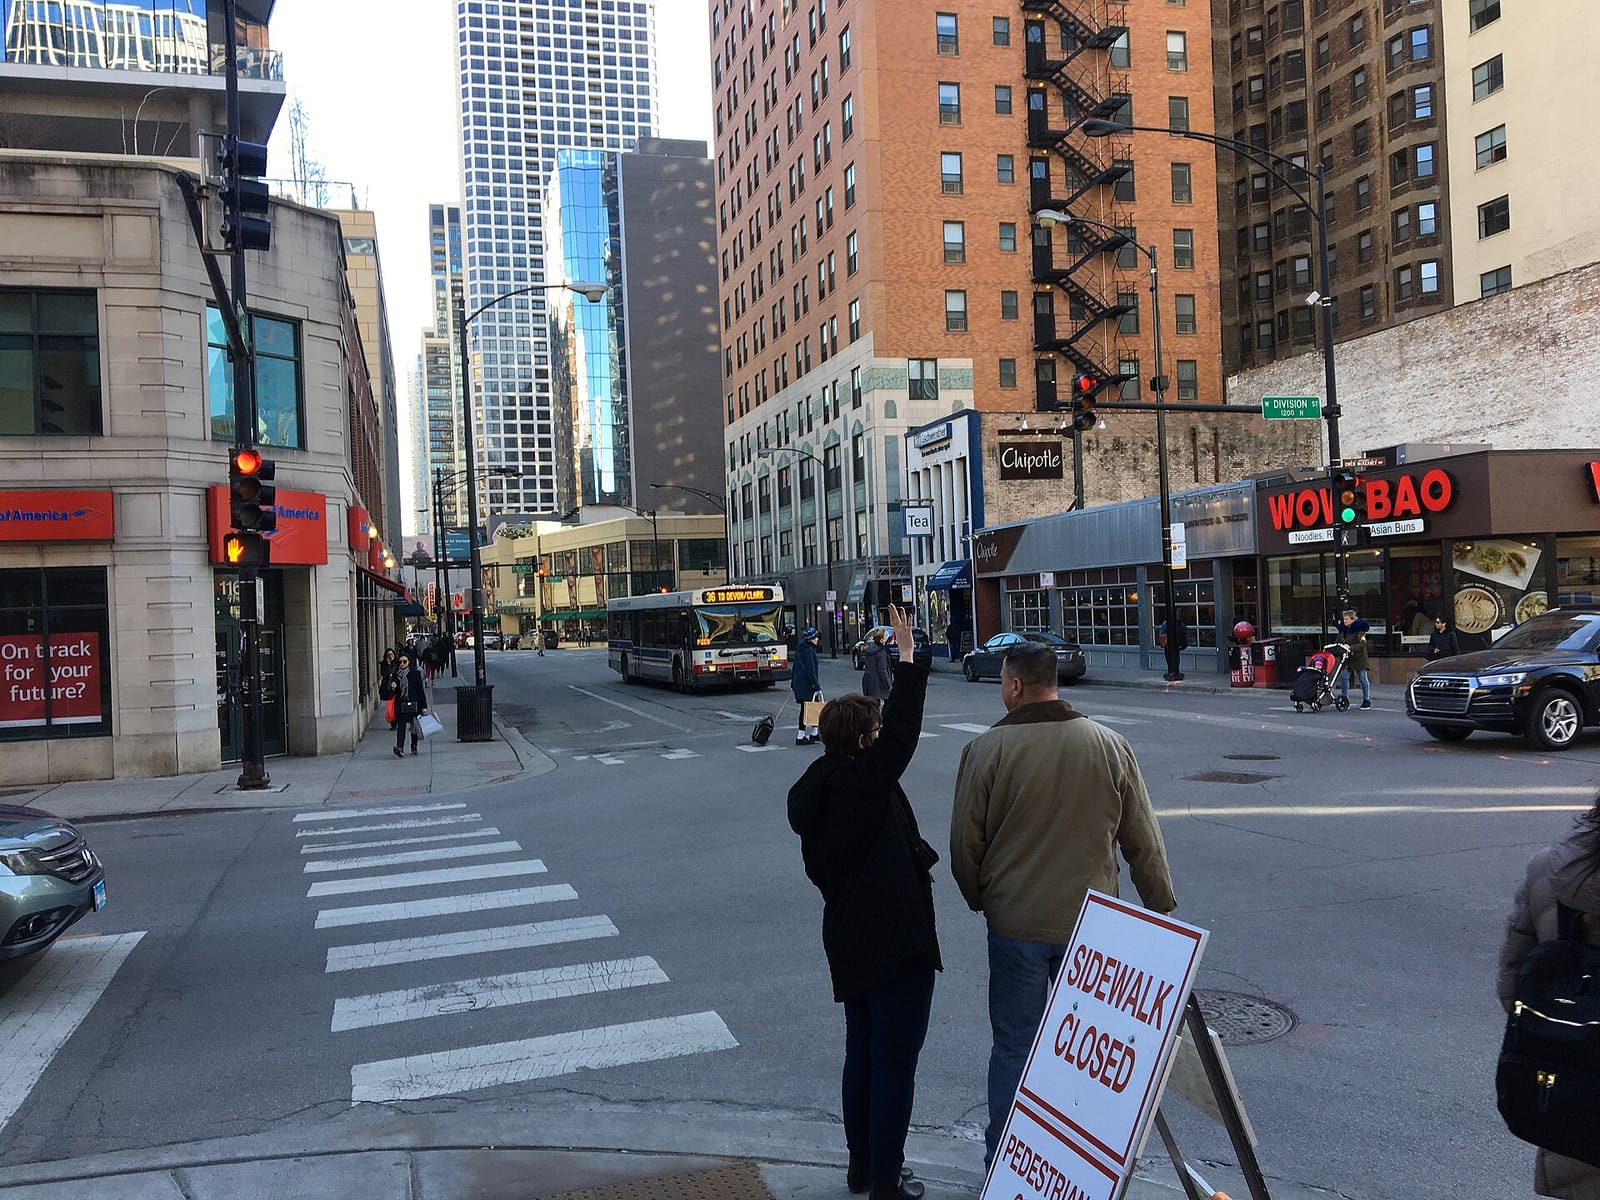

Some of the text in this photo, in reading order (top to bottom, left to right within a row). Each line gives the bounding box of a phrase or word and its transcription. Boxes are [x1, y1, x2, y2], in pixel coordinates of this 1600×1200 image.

[1273, 400, 1307, 409] DIVISION
[1002, 447, 1060, 474] Chipotle
[1365, 468, 1452, 520] BAO
[13, 508, 69, 521] America
[278, 505, 319, 520] America
[908, 514, 928, 528] Tea
[1295, 532, 1323, 542] Noodles,
[1371, 522, 1416, 535] Asian Buns
[976, 541, 999, 563] Chipotle
[706, 591, 716, 602] 36
[1, 640, 91, 660] On track
[4, 664, 92, 683] for your
[10, 682, 86, 702] future?
[1067, 944, 1175, 1031] SIDEWALK
[1054, 1013, 1136, 1094] CLOSED
